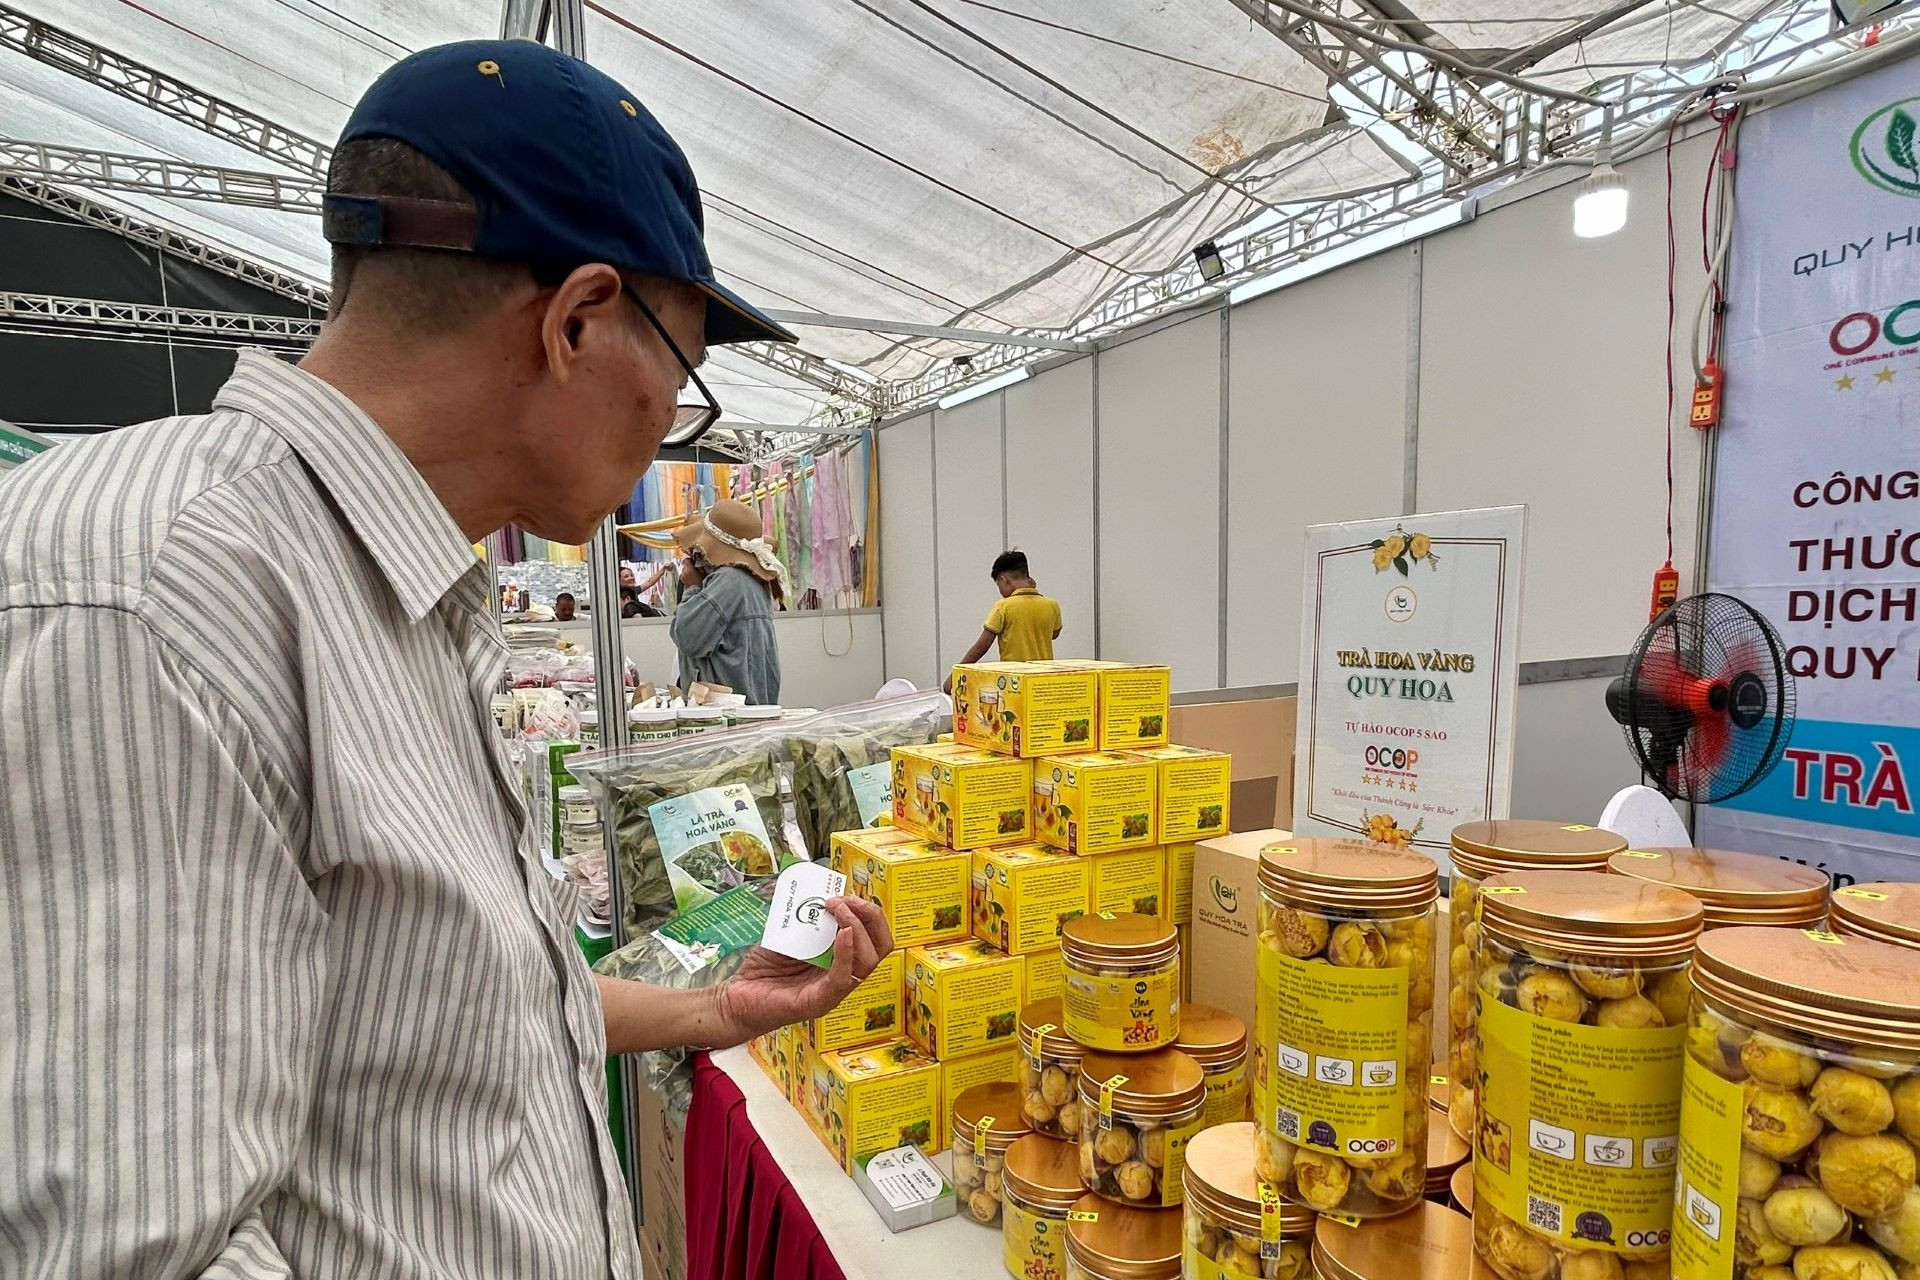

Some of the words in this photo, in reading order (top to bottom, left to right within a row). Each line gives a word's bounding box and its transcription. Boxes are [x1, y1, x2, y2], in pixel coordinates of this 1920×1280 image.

[1793, 236, 1874, 276] QUY
[1793, 470, 1919, 508] CÔNG
[1788, 587, 1916, 628] DỊCH
[1337, 646, 1373, 668] TRÀ
[1374, 650, 1416, 671] HOA
[1416, 648, 1475, 673] VÀNG
[1784, 645, 1896, 681] QUY
[1347, 674, 1395, 700] QUY
[1398, 677, 1455, 702] HOA
[1361, 722, 1383, 734] HÀO
[1385, 725, 1415, 738] OCOP
[1416, 729, 1423, 739] 5
[1424, 729, 1447, 741] SAO
[1365, 745, 1419, 771] OCOP
[1784, 741, 1914, 814] TRÀ
[705, 807, 725, 820] TRÀ
[685, 826, 708, 839] HOA
[709, 817, 736, 832] VÀNG
[786, 896, 794, 912] HOA
[1199, 908, 1214, 919] QUY
[1349, 1139, 1396, 1153] OCOP
[1627, 1228, 1672, 1247] OCO
